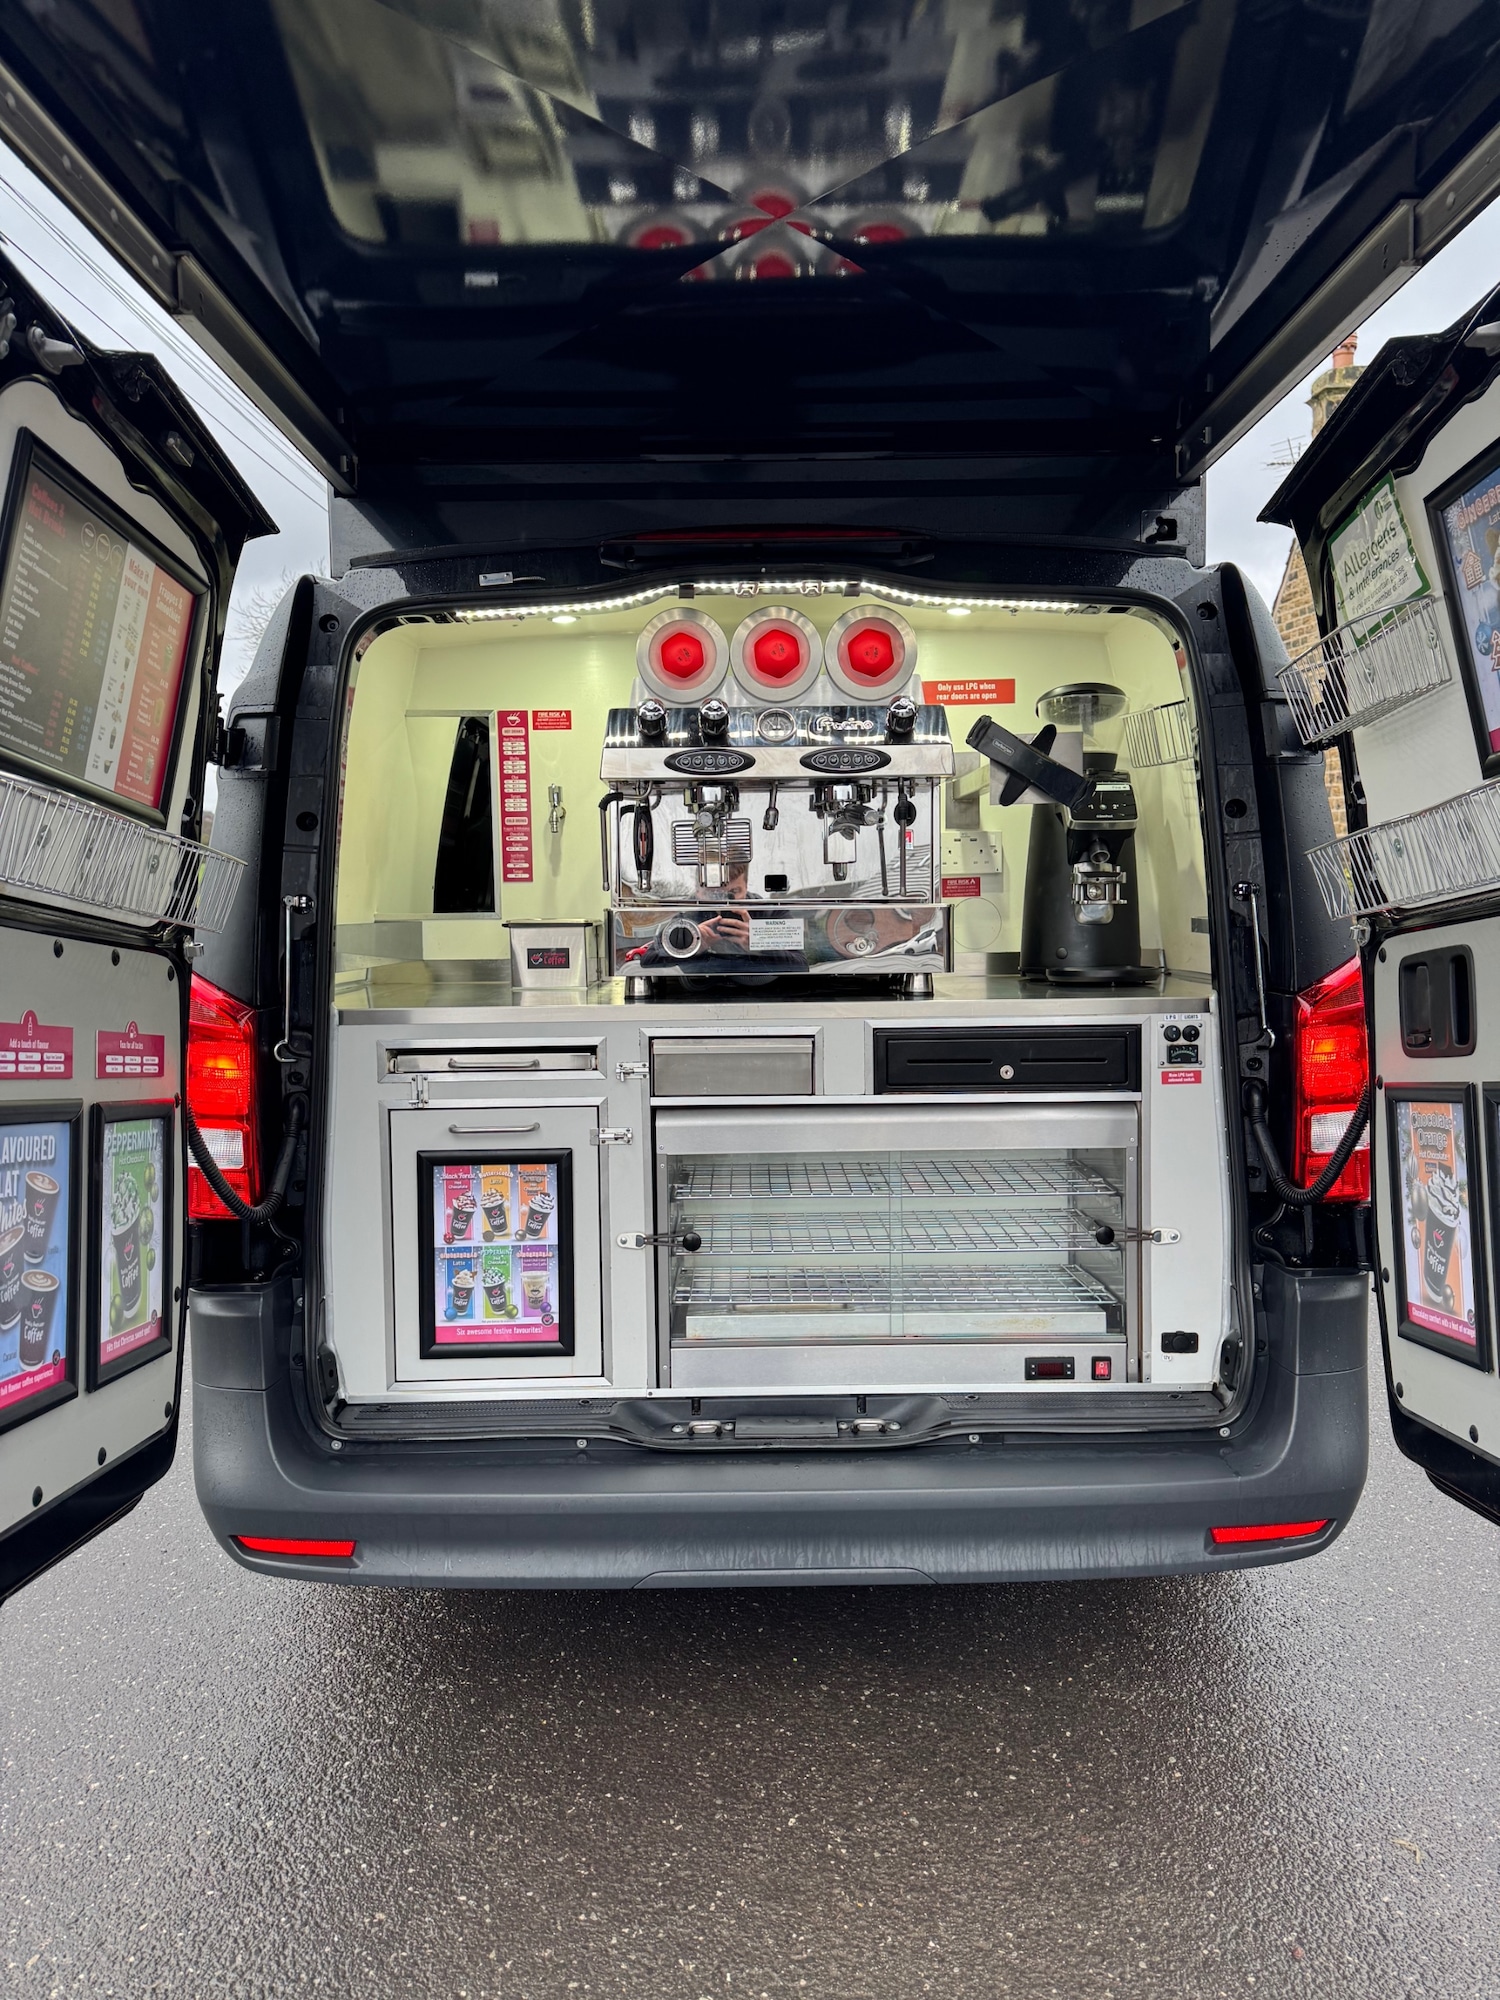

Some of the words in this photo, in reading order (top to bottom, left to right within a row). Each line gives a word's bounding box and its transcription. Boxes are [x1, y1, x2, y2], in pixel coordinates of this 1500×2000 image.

[1343, 520, 1397, 583] Allergens
[938, 683, 951, 692] Only
[544, 955, 566, 965] Coffee
[1411, 1111, 1452, 1130] Chocolate
[0, 1135, 56, 1164] AVOURED
[106, 1129, 158, 1155] PEPPERMINT
[1417, 1128, 1448, 1150] Orange
[0, 1170, 20, 1198] AT
[0, 1198, 27, 1232] hites
[453, 1221, 467, 1229] Coffee
[528, 1220, 542, 1230] Coffee
[27, 1222, 45, 1238] Coffee
[1427, 1247, 1445, 1275] Coffee
[122, 1265, 138, 1288] Coffee
[0, 1280, 20, 1302] Coffee
[24, 1326, 44, 1343] Coffee
[22, 1376, 33, 1388] coffee
[34, 1368, 54, 1383] experience!
